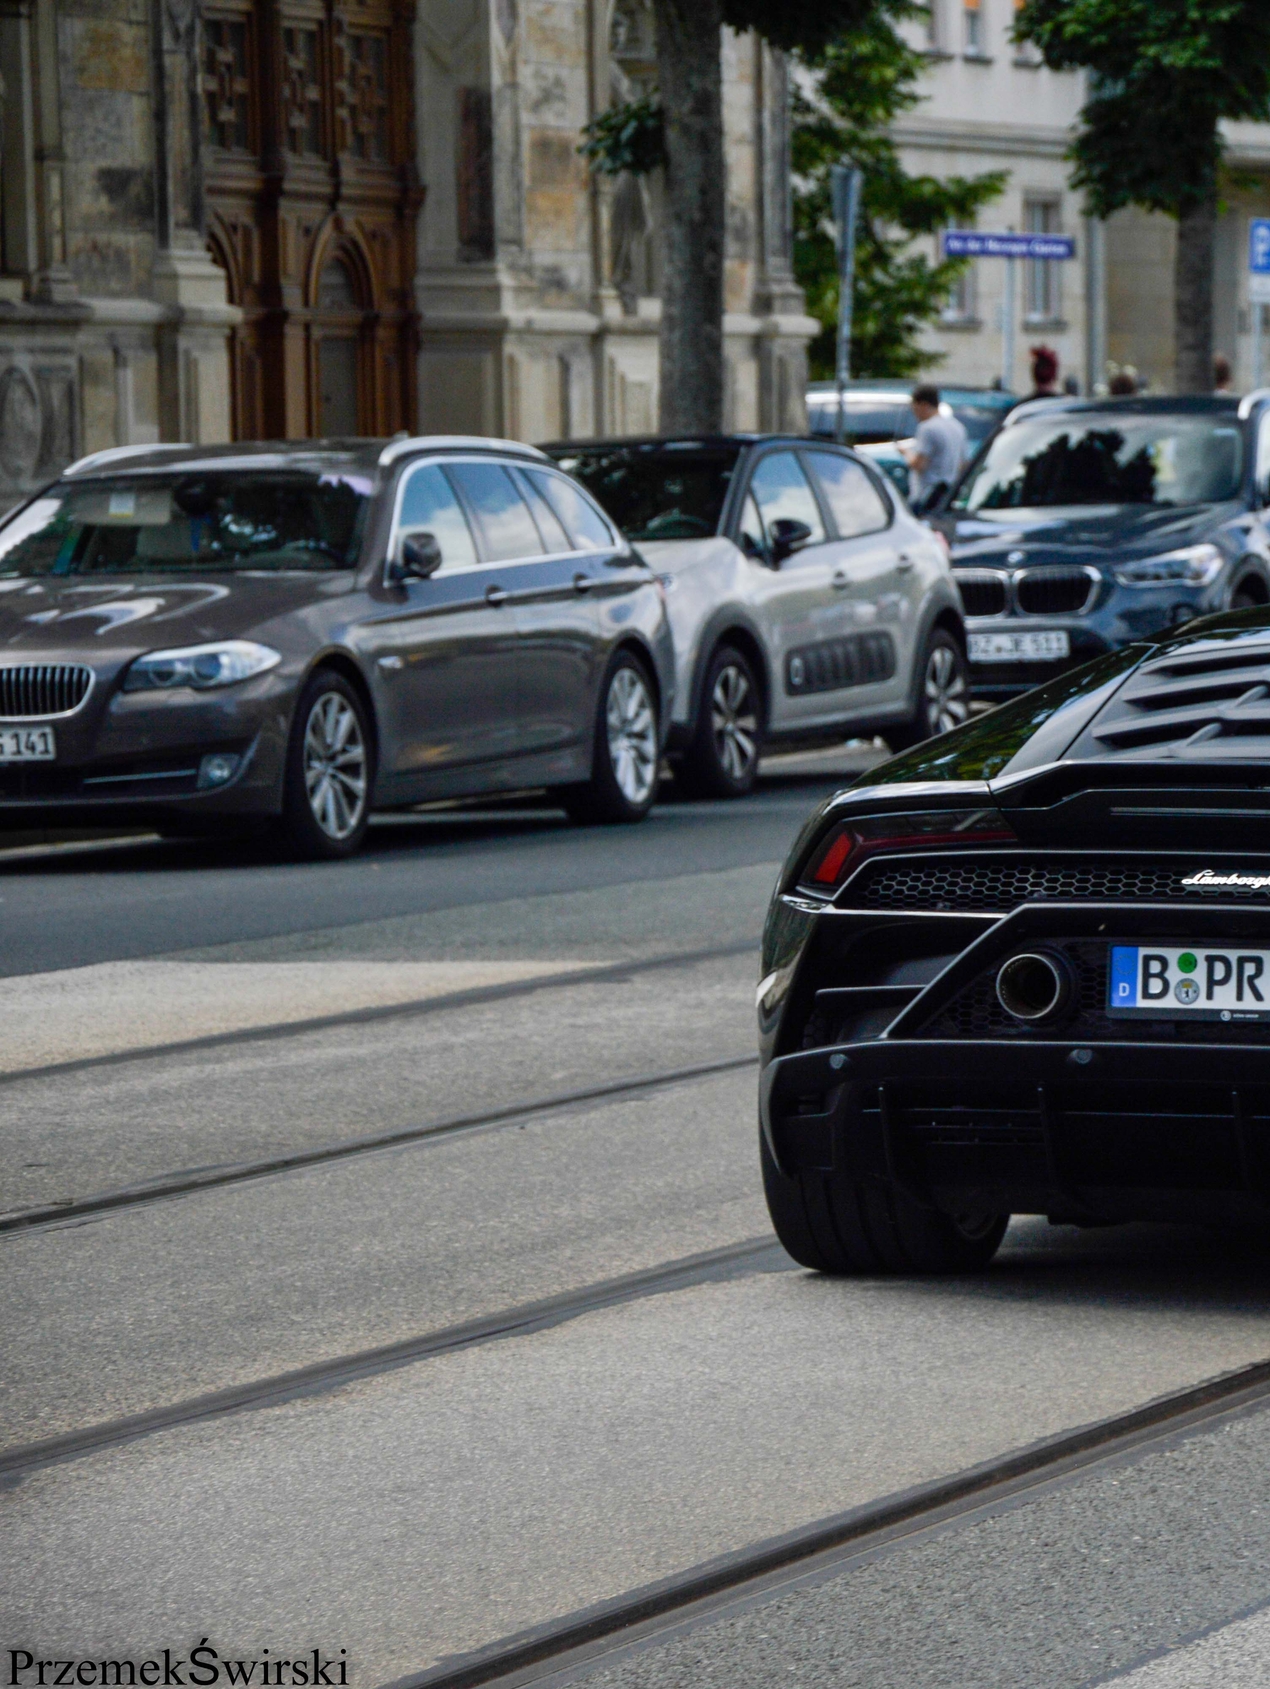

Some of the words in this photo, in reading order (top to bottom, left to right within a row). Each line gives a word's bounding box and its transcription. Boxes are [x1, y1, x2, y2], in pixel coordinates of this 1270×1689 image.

[10, 732, 50, 756] 141
[1119, 983, 1129, 996] D
[1142, 954, 1170, 1000] B
[1204, 954, 1264, 1001] PR
